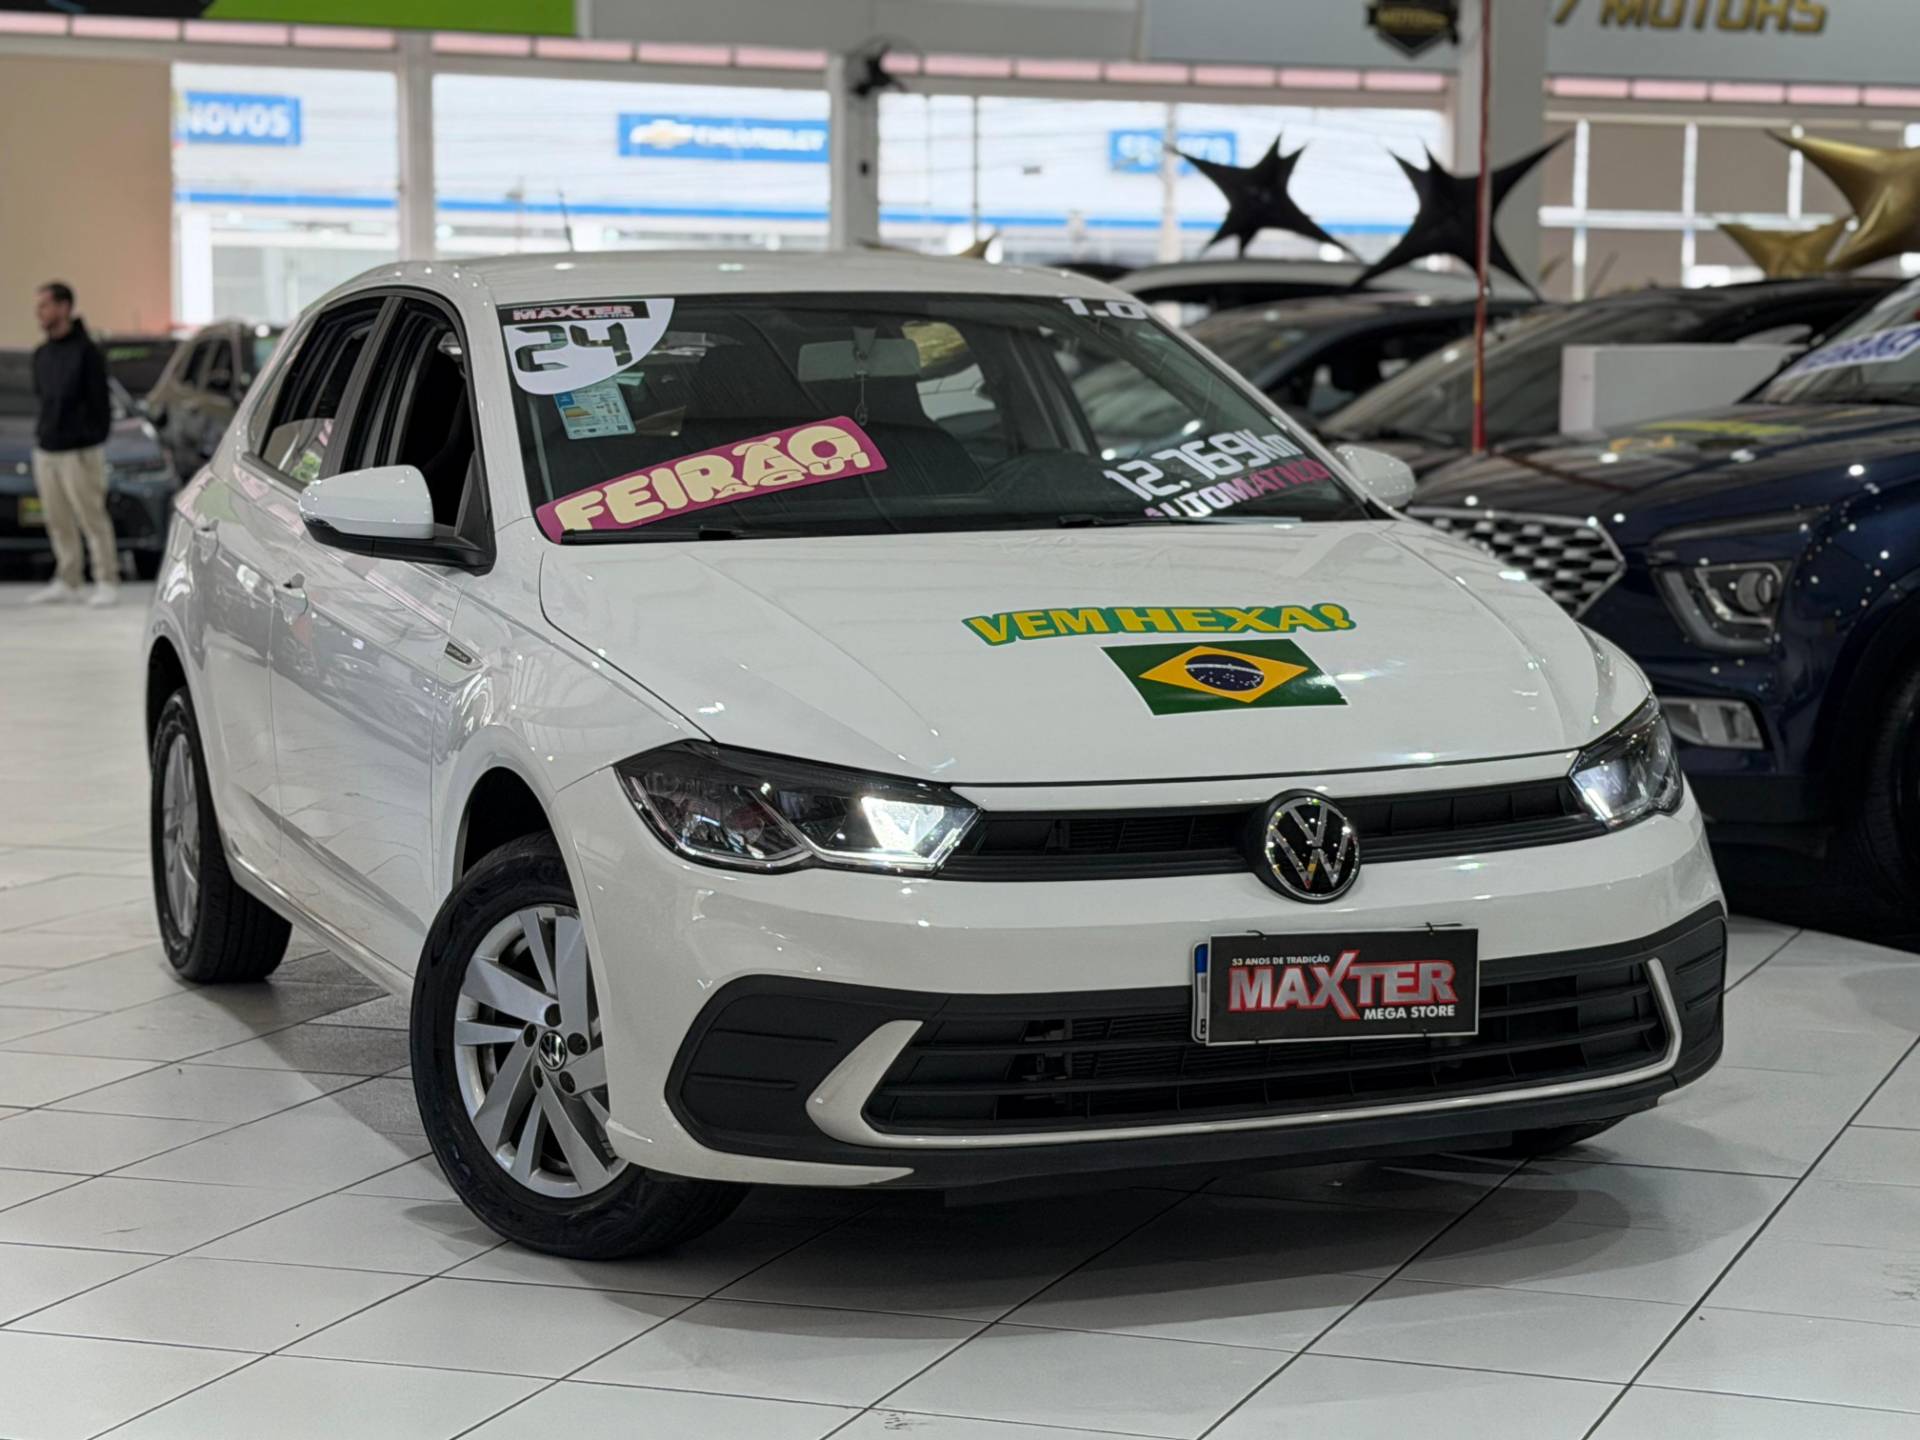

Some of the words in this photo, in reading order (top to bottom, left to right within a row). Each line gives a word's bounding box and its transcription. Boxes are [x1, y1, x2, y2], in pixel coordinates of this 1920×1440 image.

[513, 304, 634, 321] MAXTER
[514, 322, 633, 372] 24
[555, 425, 861, 530] FEIRÃO
[964, 607, 1112, 646] VEM
[1245, 957, 1270, 965] ANOS
[1272, 956, 1284, 965] DE
[1228, 949, 1458, 1021] MAXTER
[1363, 1006, 1404, 1020] MEGA
[1410, 1004, 1456, 1018] STORE
